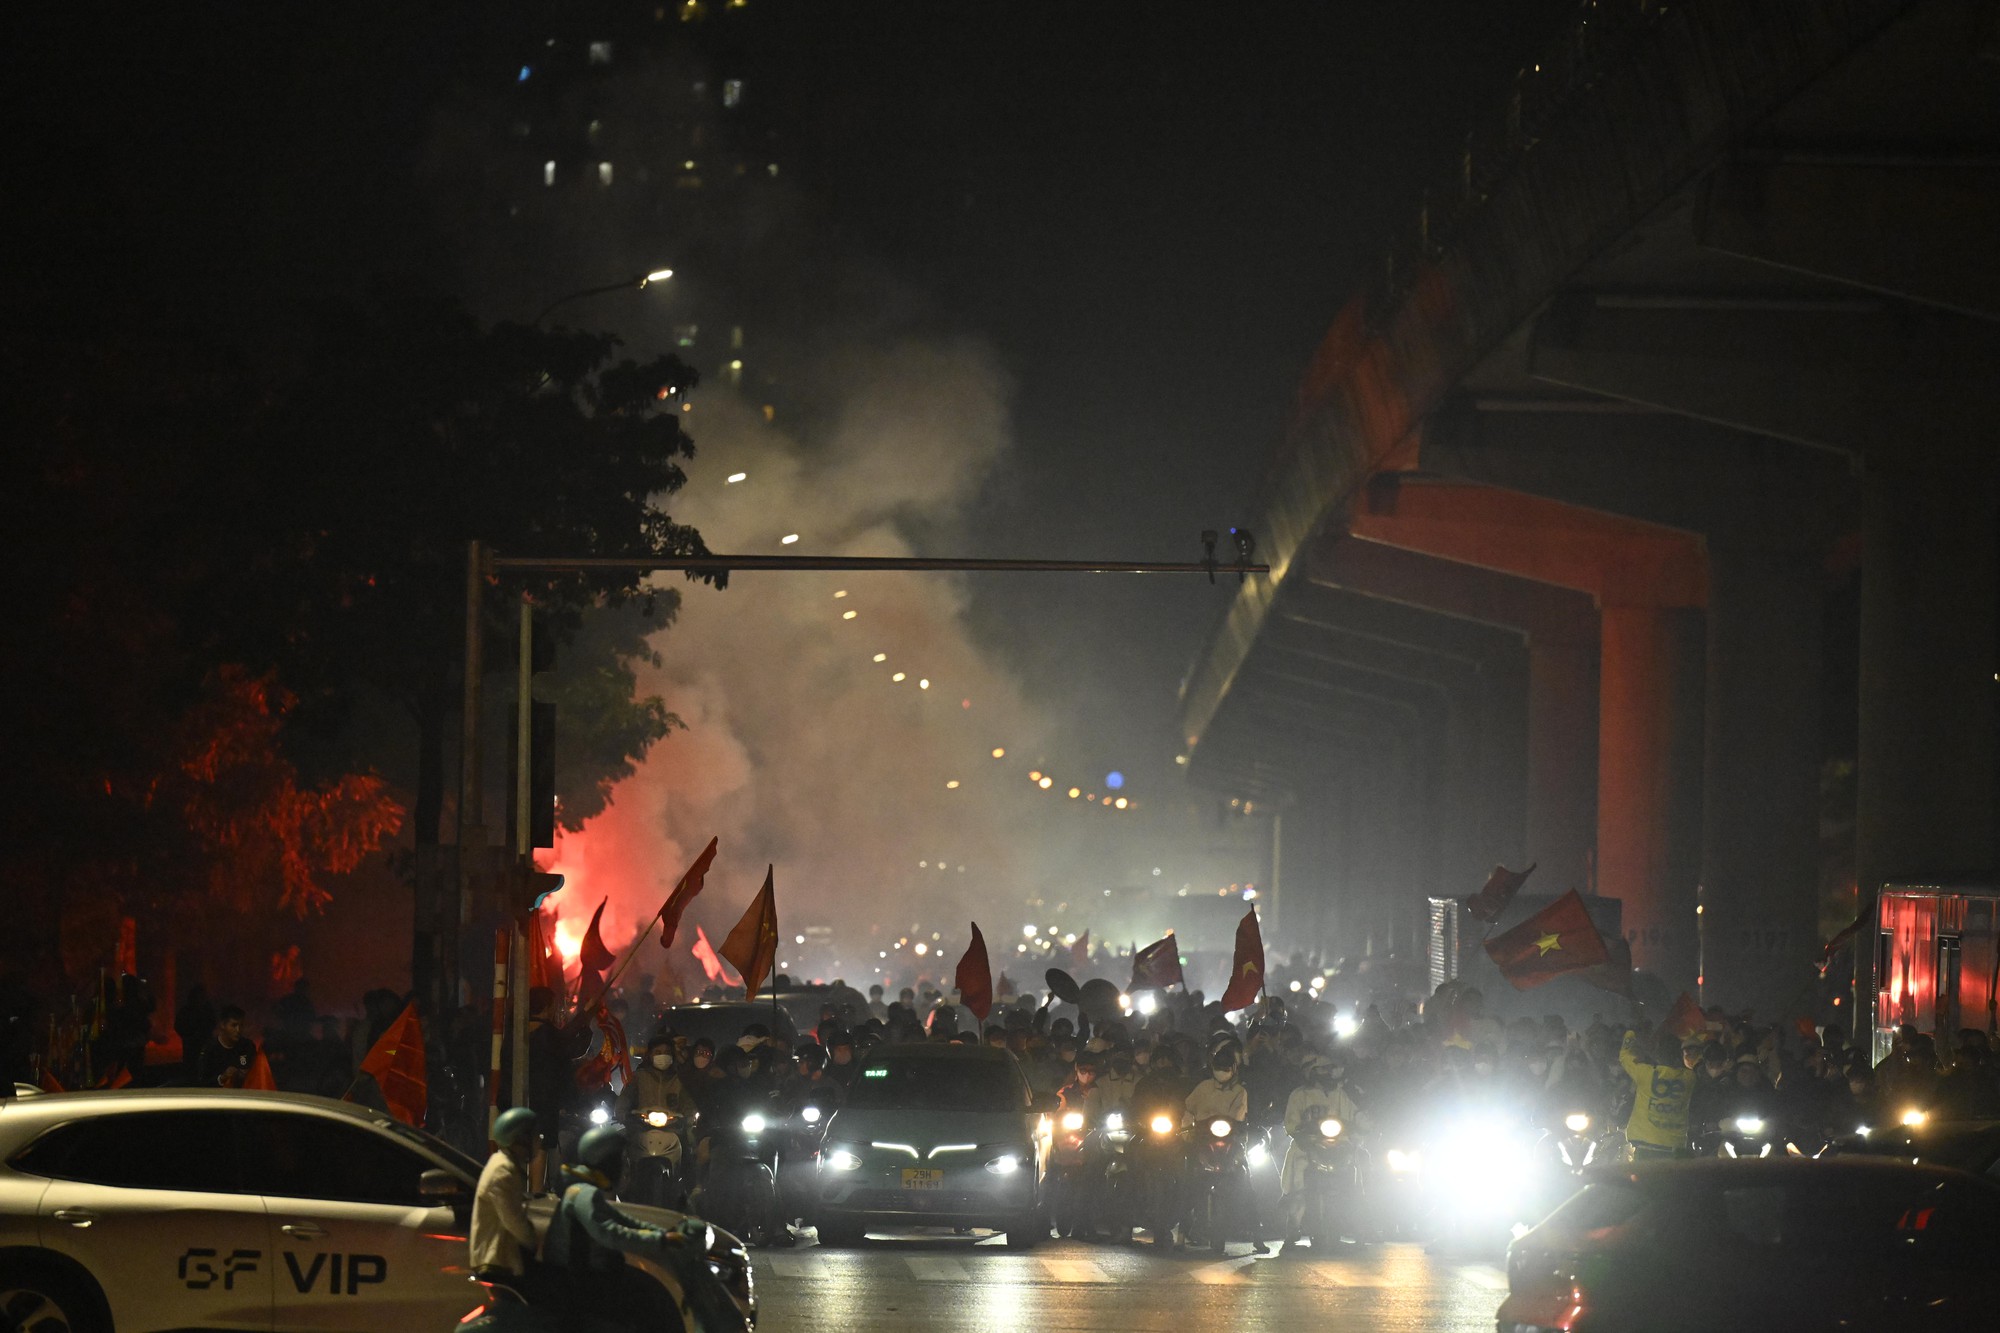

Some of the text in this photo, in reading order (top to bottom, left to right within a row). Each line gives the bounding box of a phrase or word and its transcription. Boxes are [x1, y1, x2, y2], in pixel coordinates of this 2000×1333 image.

[1651, 1069, 1686, 1099] be
[912, 1170, 931, 1179] 29H
[283, 1252, 387, 1295] VIP
